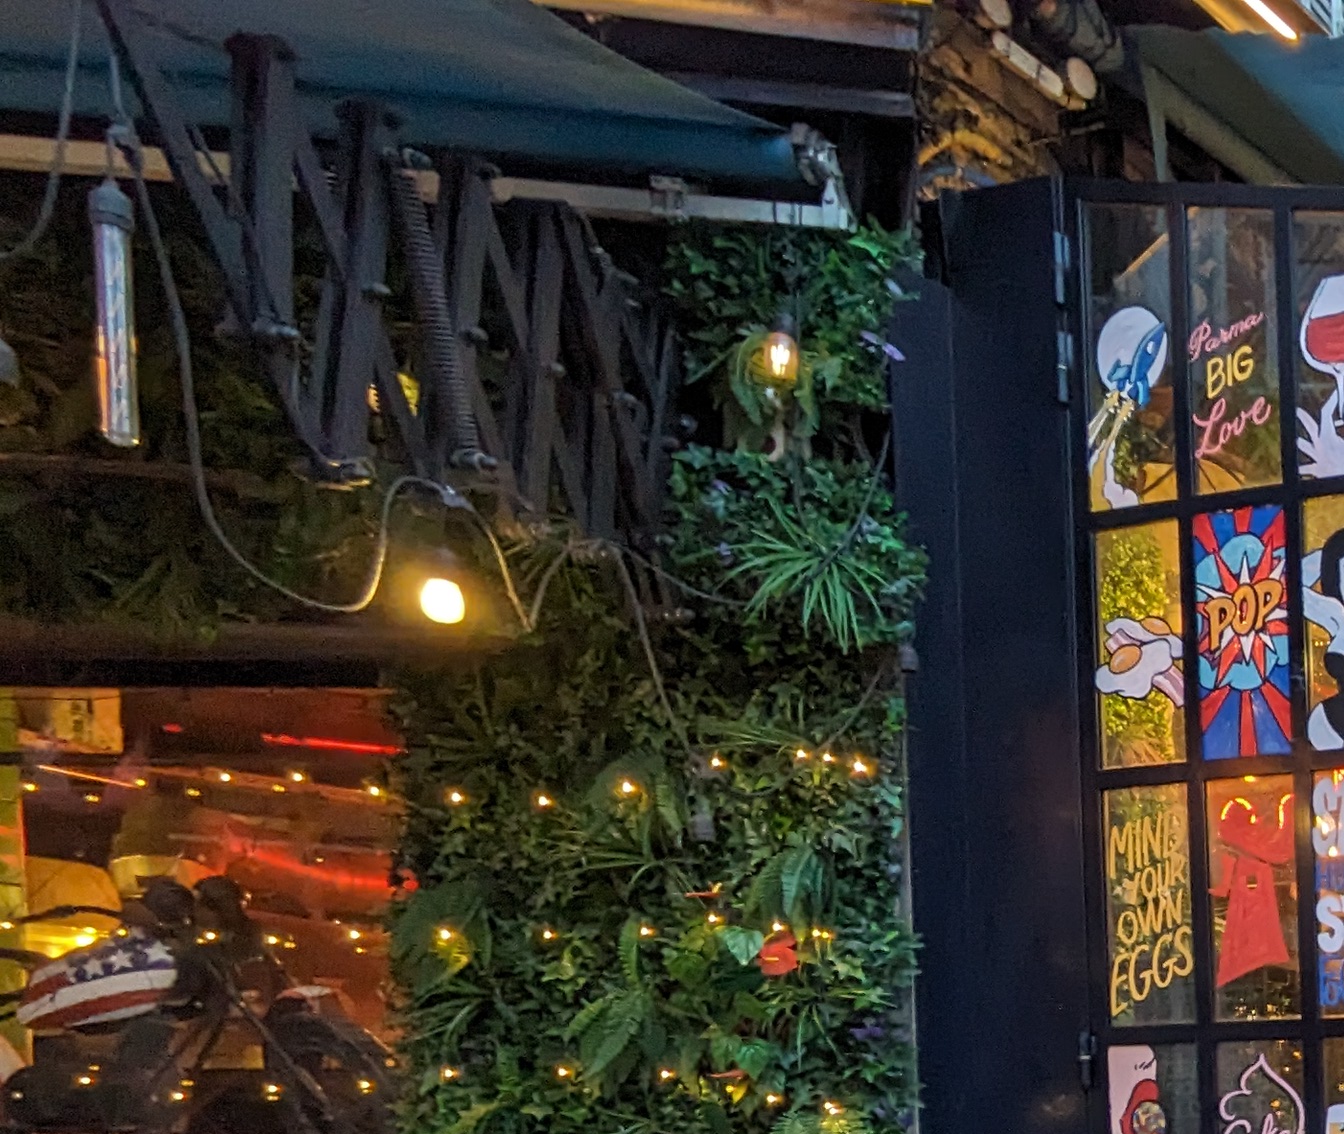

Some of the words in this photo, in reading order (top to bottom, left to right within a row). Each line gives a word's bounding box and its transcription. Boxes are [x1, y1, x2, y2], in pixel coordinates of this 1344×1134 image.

[1188, 311, 1265, 362] Parma
[1206, 344, 1254, 399] BIG
[1192, 396, 1272, 460] Love
[1203, 578, 1284, 652] POP
[1109, 811, 1187, 880] MIND
[1121, 851, 1187, 905] YOUR
[1117, 888, 1184, 945] OWN
[1109, 925, 1195, 1017] EGGS
